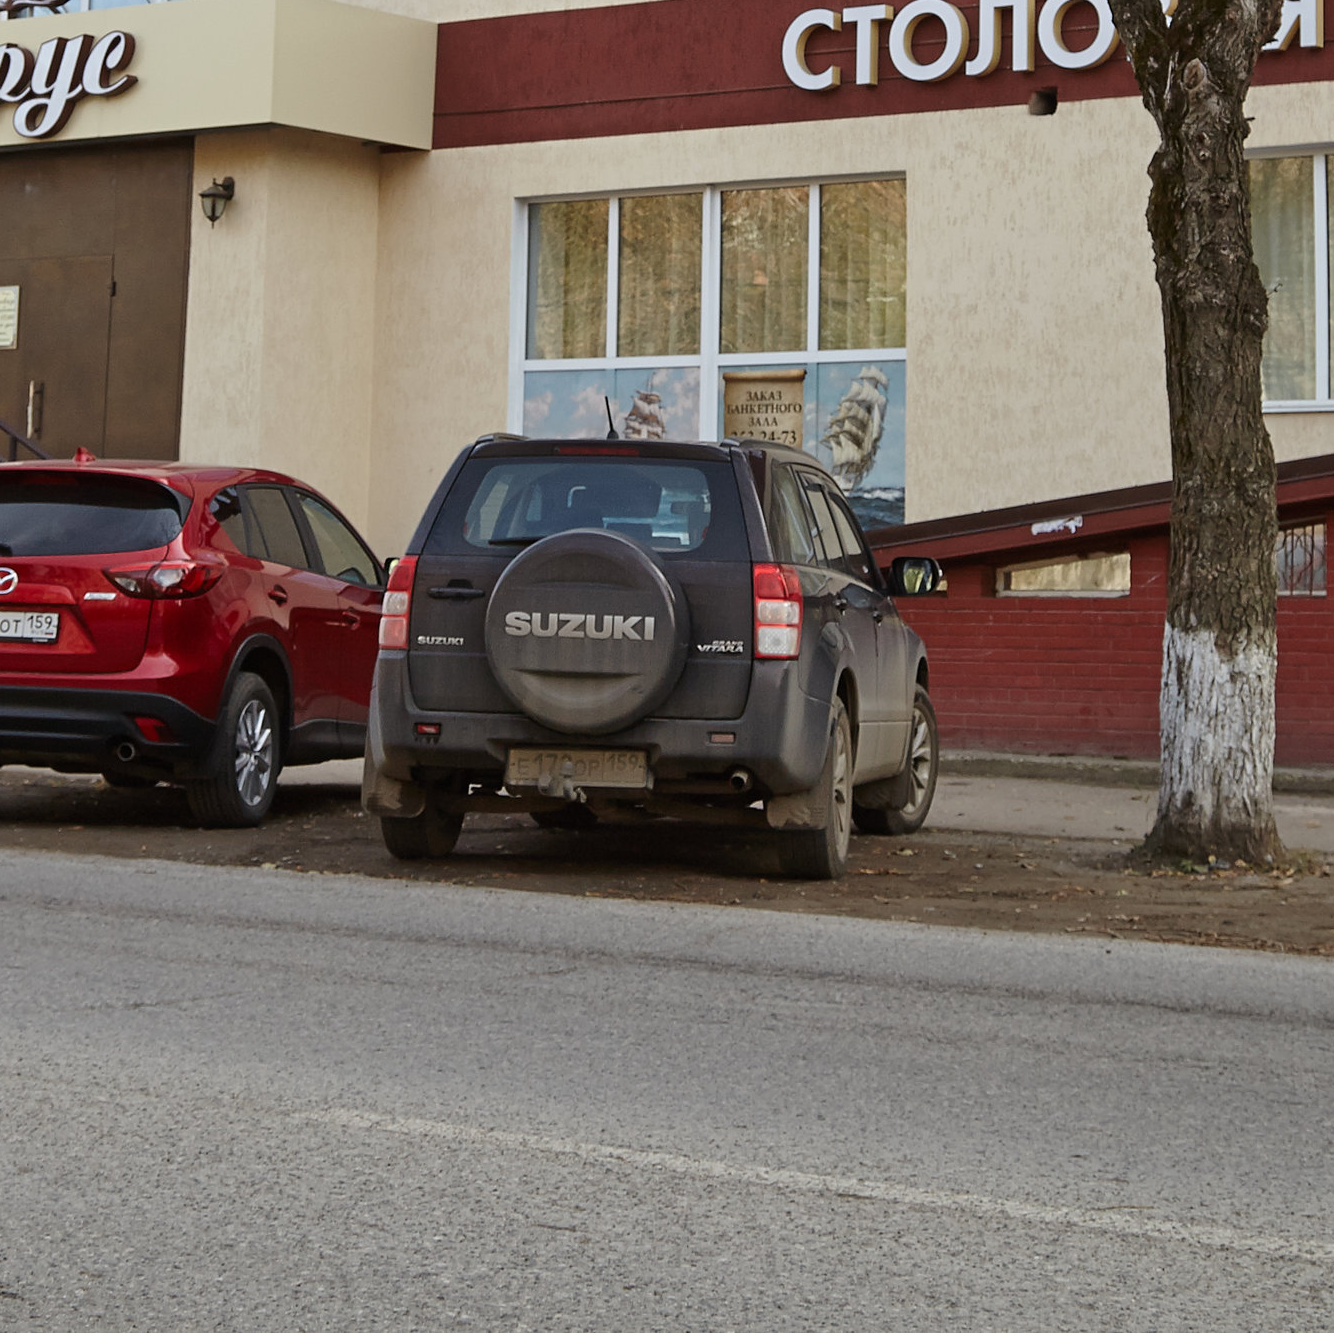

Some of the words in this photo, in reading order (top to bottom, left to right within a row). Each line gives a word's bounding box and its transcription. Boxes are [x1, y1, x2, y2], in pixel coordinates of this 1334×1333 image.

[746, 390, 782, 402] ЗАКАЗ
[727, 403, 802, 415] БАНКЕТНОГО
[747, 416, 778, 427] ЗАЛА
[27, 615, 53, 630] 159
[504, 611, 655, 642] SUZUKI
[417, 636, 464, 646] SUZUKI
[697, 644, 743, 652] VITARA
[607, 754, 639, 772] 159
